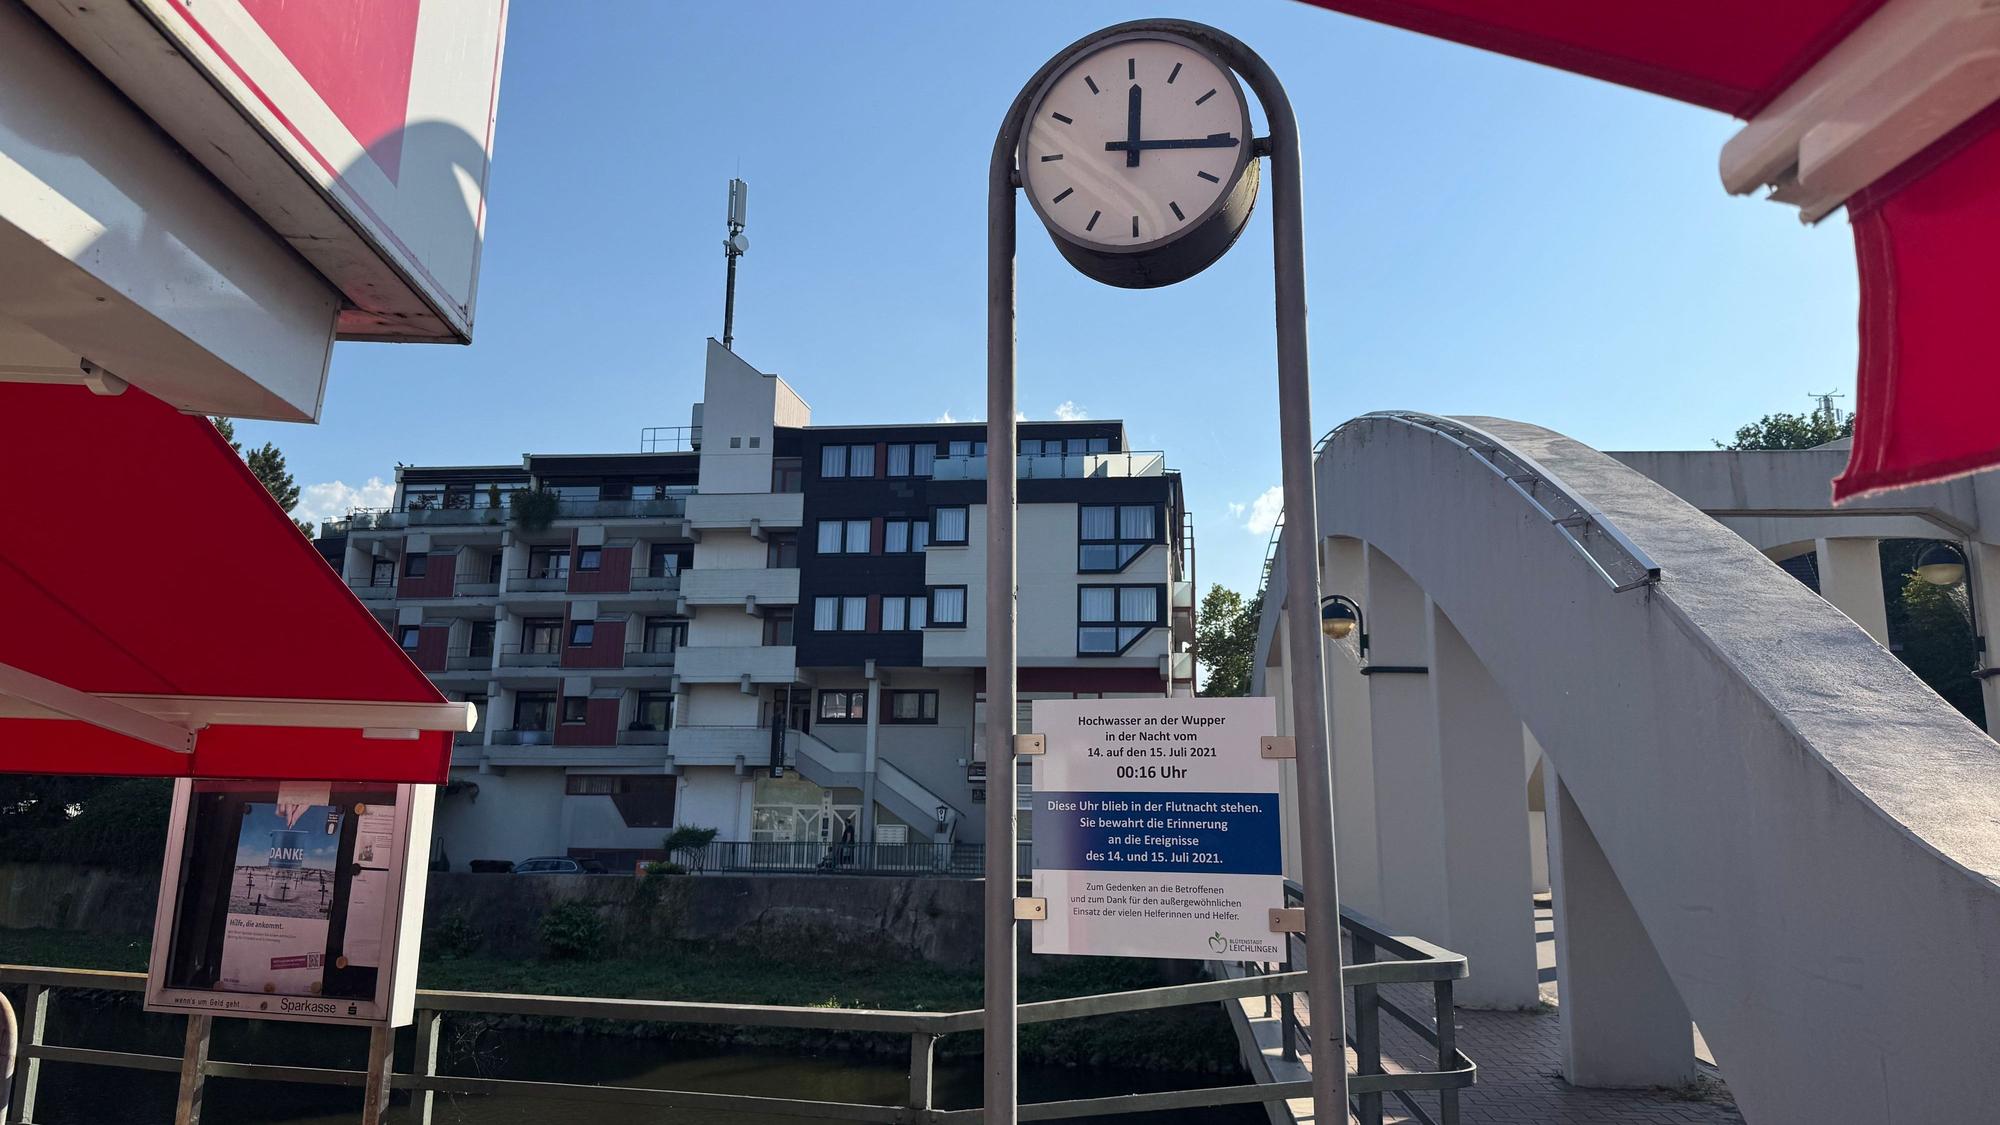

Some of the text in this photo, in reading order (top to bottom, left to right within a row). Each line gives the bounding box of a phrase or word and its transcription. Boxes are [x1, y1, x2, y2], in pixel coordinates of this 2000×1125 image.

[1078, 716, 1141, 726] Hochwasser
[1160, 715, 1178, 725] der
[1181, 716, 1226, 727] Wupper
[1105, 731, 1197, 741] in der Nacht vom
[1087, 747, 1217, 757] 14. auf den 15. Juli 2021
[1116, 765, 1188, 779] 00:16 Uhr
[1047, 801, 1262, 813] Diese Uhr blieb in der Flutnacht stehen.
[1080, 818, 1228, 832] Sie bewahrt die Erinnerung
[1108, 834, 1200, 848] an die Ereignisse
[1086, 850, 1223, 864] des 14. und 15. Juli 2021.
[1086, 882, 1225, 894] Zum Gedenken an die Betroffenen
[1070, 895, 1086, 903] und
[1106, 896, 1127, 904] Dank
[1129, 896, 1141, 905] für
[1142, 897, 1159, 905] den
[1160, 897, 1242, 908] außergewöhnlichen
[1073, 907, 1240, 921] Einsatz der vielen Helferinnen und Helfer.
[246, 920, 255, 928] die
[1229, 944, 1278, 953] LEICHLINGEN
[209, 998, 224, 1007] Geld
[226, 1000, 240, 1009] geht
[280, 997, 337, 1014] Sparkasse
